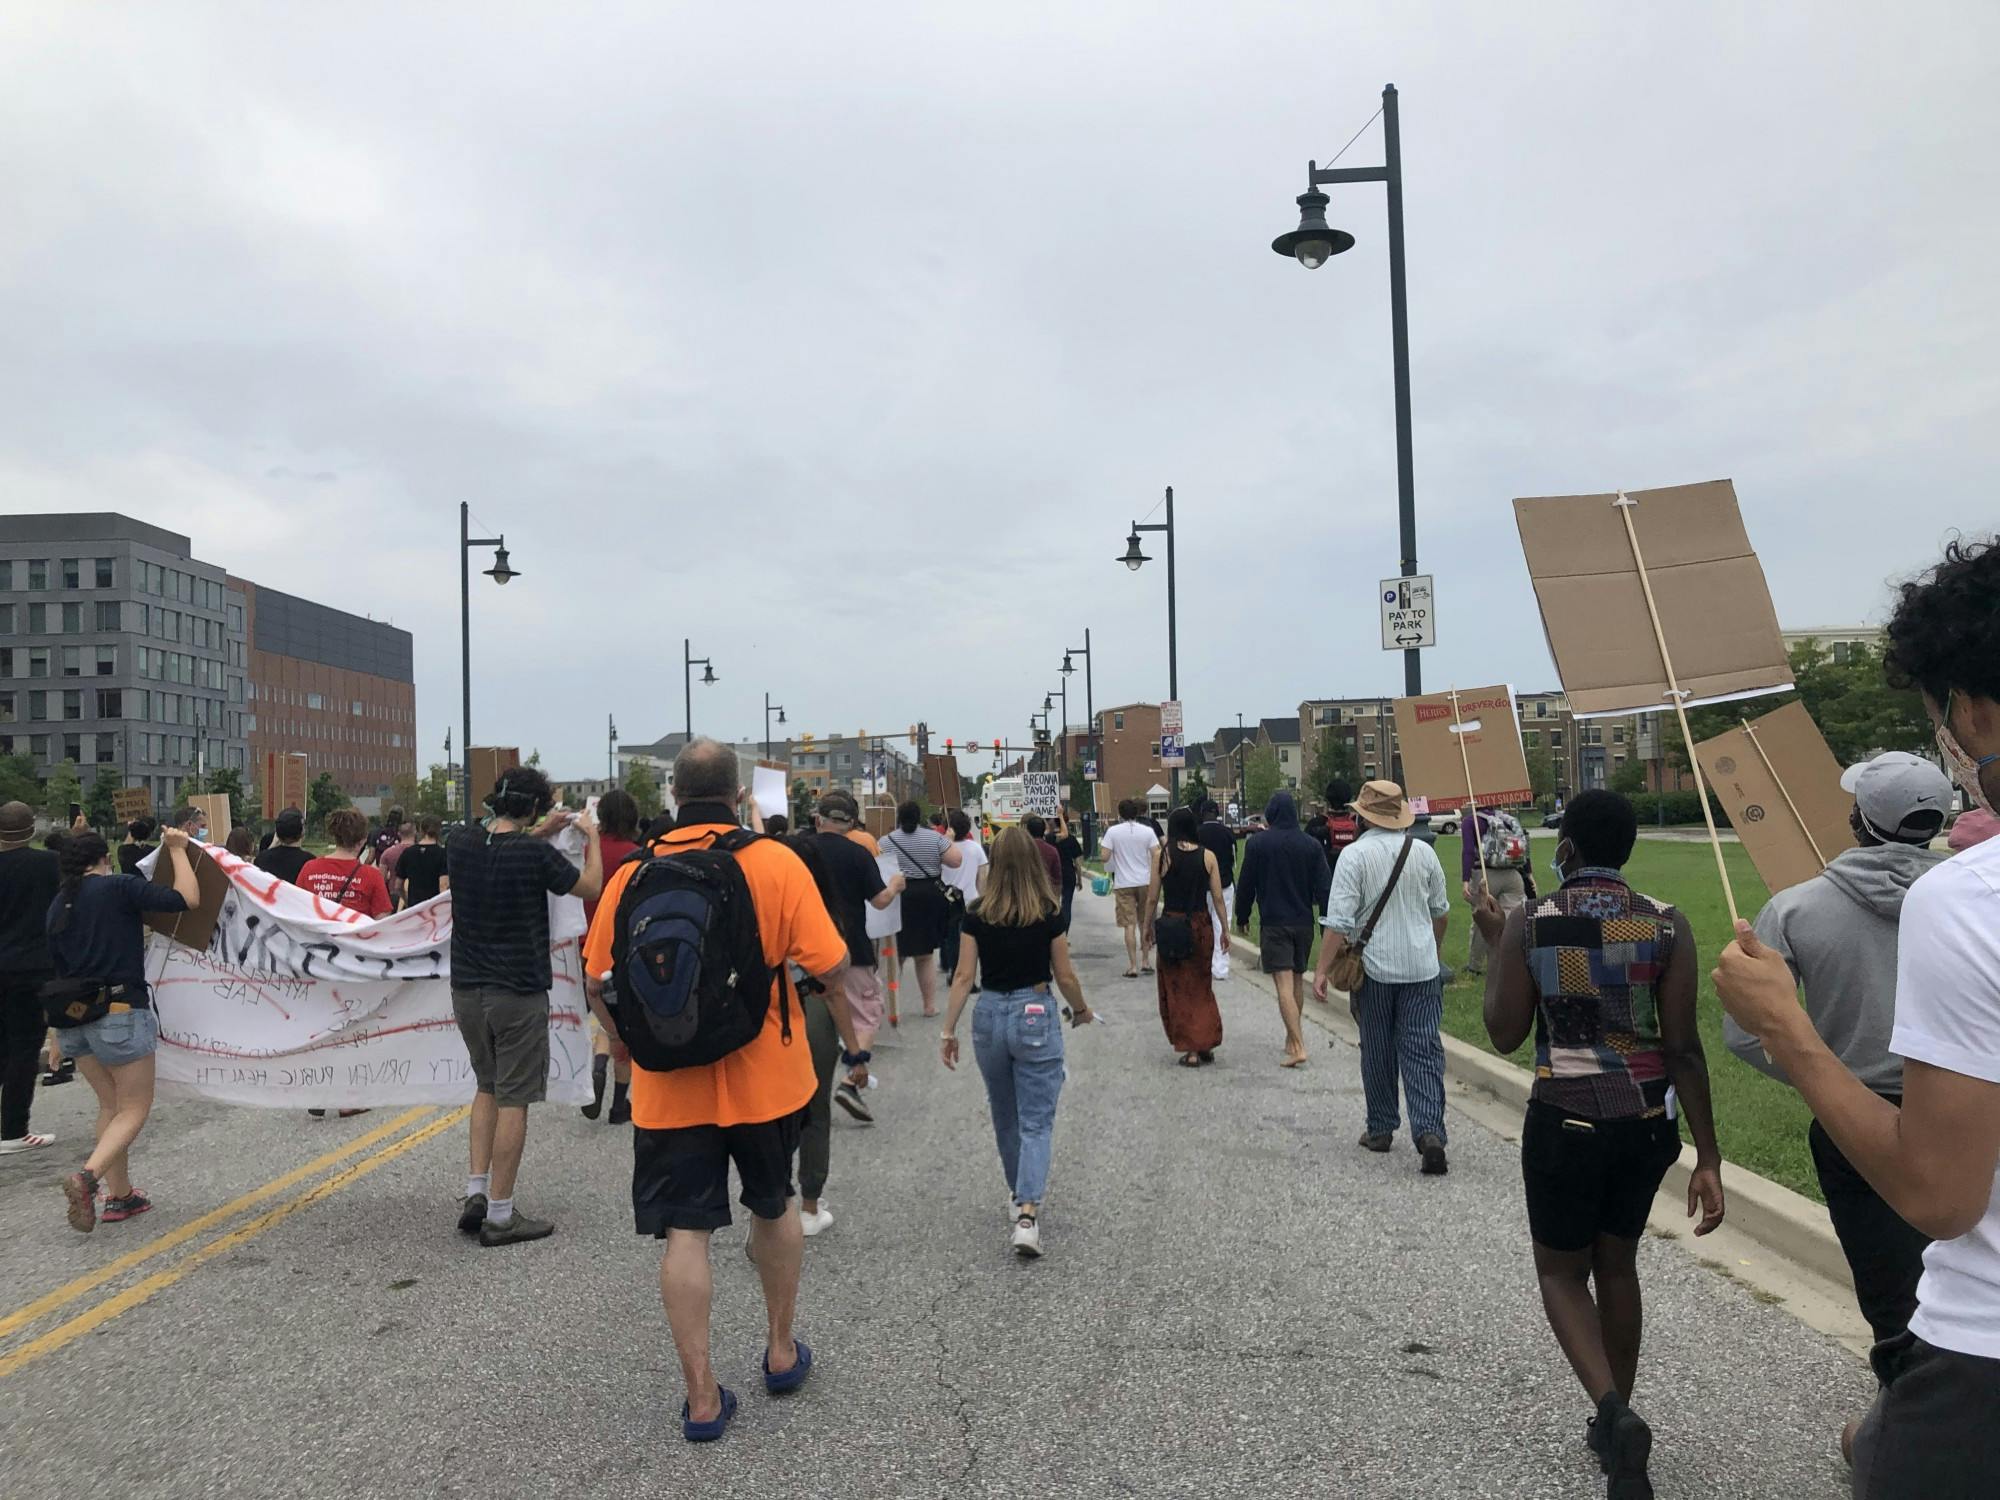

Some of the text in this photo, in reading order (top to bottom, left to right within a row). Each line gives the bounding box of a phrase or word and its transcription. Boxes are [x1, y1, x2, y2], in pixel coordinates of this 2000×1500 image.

[1388, 609, 1426, 622] PAY TO
[1393, 620, 1422, 631] PARK
[1023, 773, 1058, 786] BREONNA
[1024, 785, 1057, 796] TAYLOR
[1024, 796, 1038, 806] SAY
[1039, 796, 1056, 806] HER
[313, 882, 334, 891] Heal
[318, 890, 356, 899] Ameca
